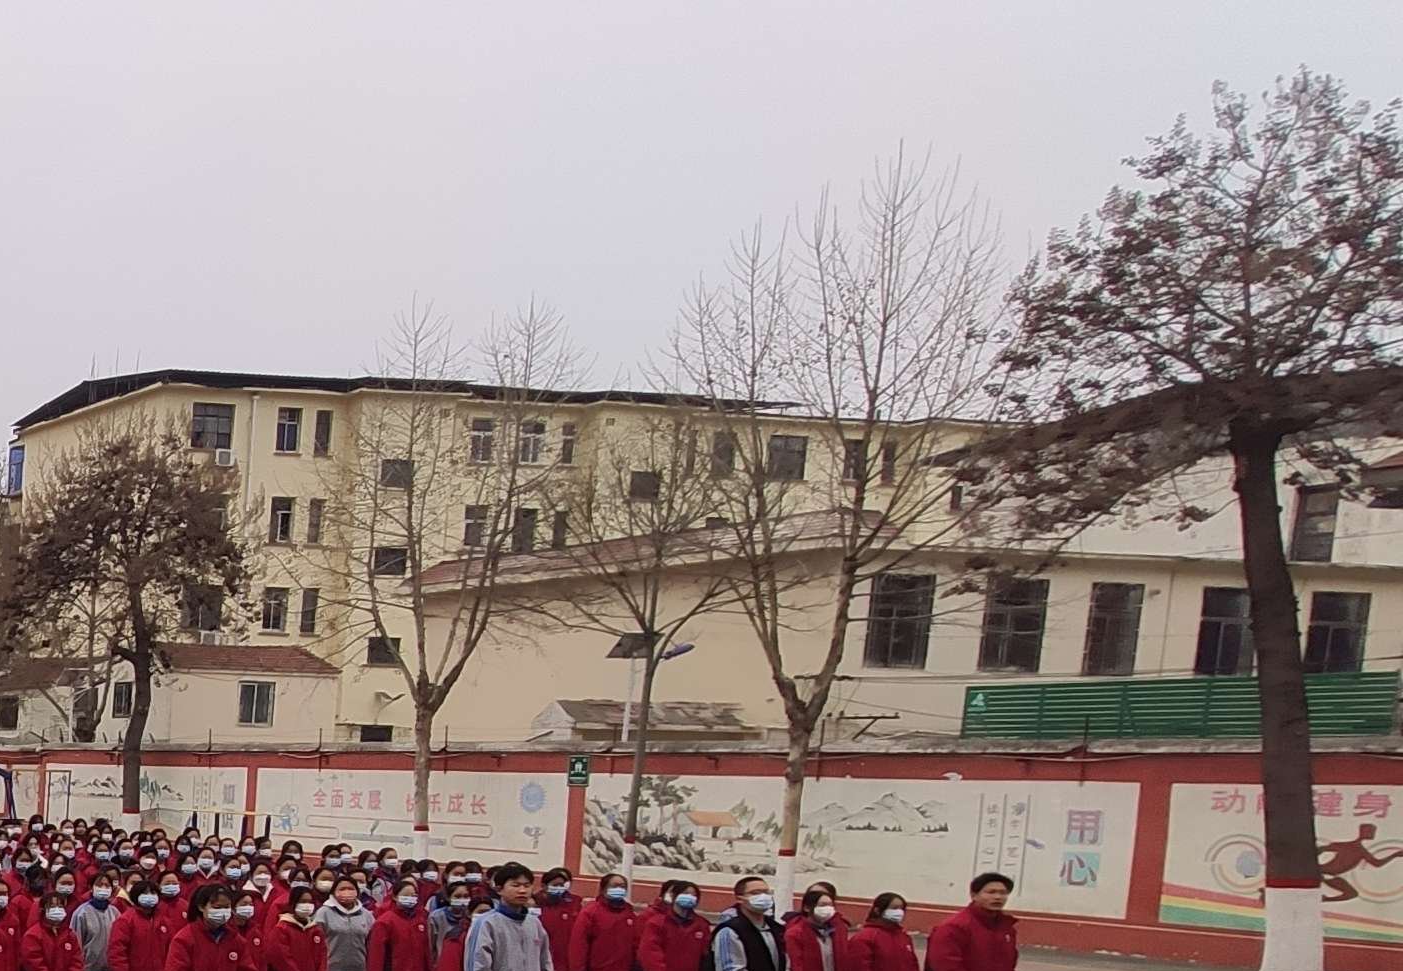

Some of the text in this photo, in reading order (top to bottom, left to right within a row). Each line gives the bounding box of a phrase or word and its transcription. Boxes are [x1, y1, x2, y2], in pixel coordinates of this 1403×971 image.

[1211, 788, 1393, 819] 动健身
[1059, 808, 1104, 886] 用心
